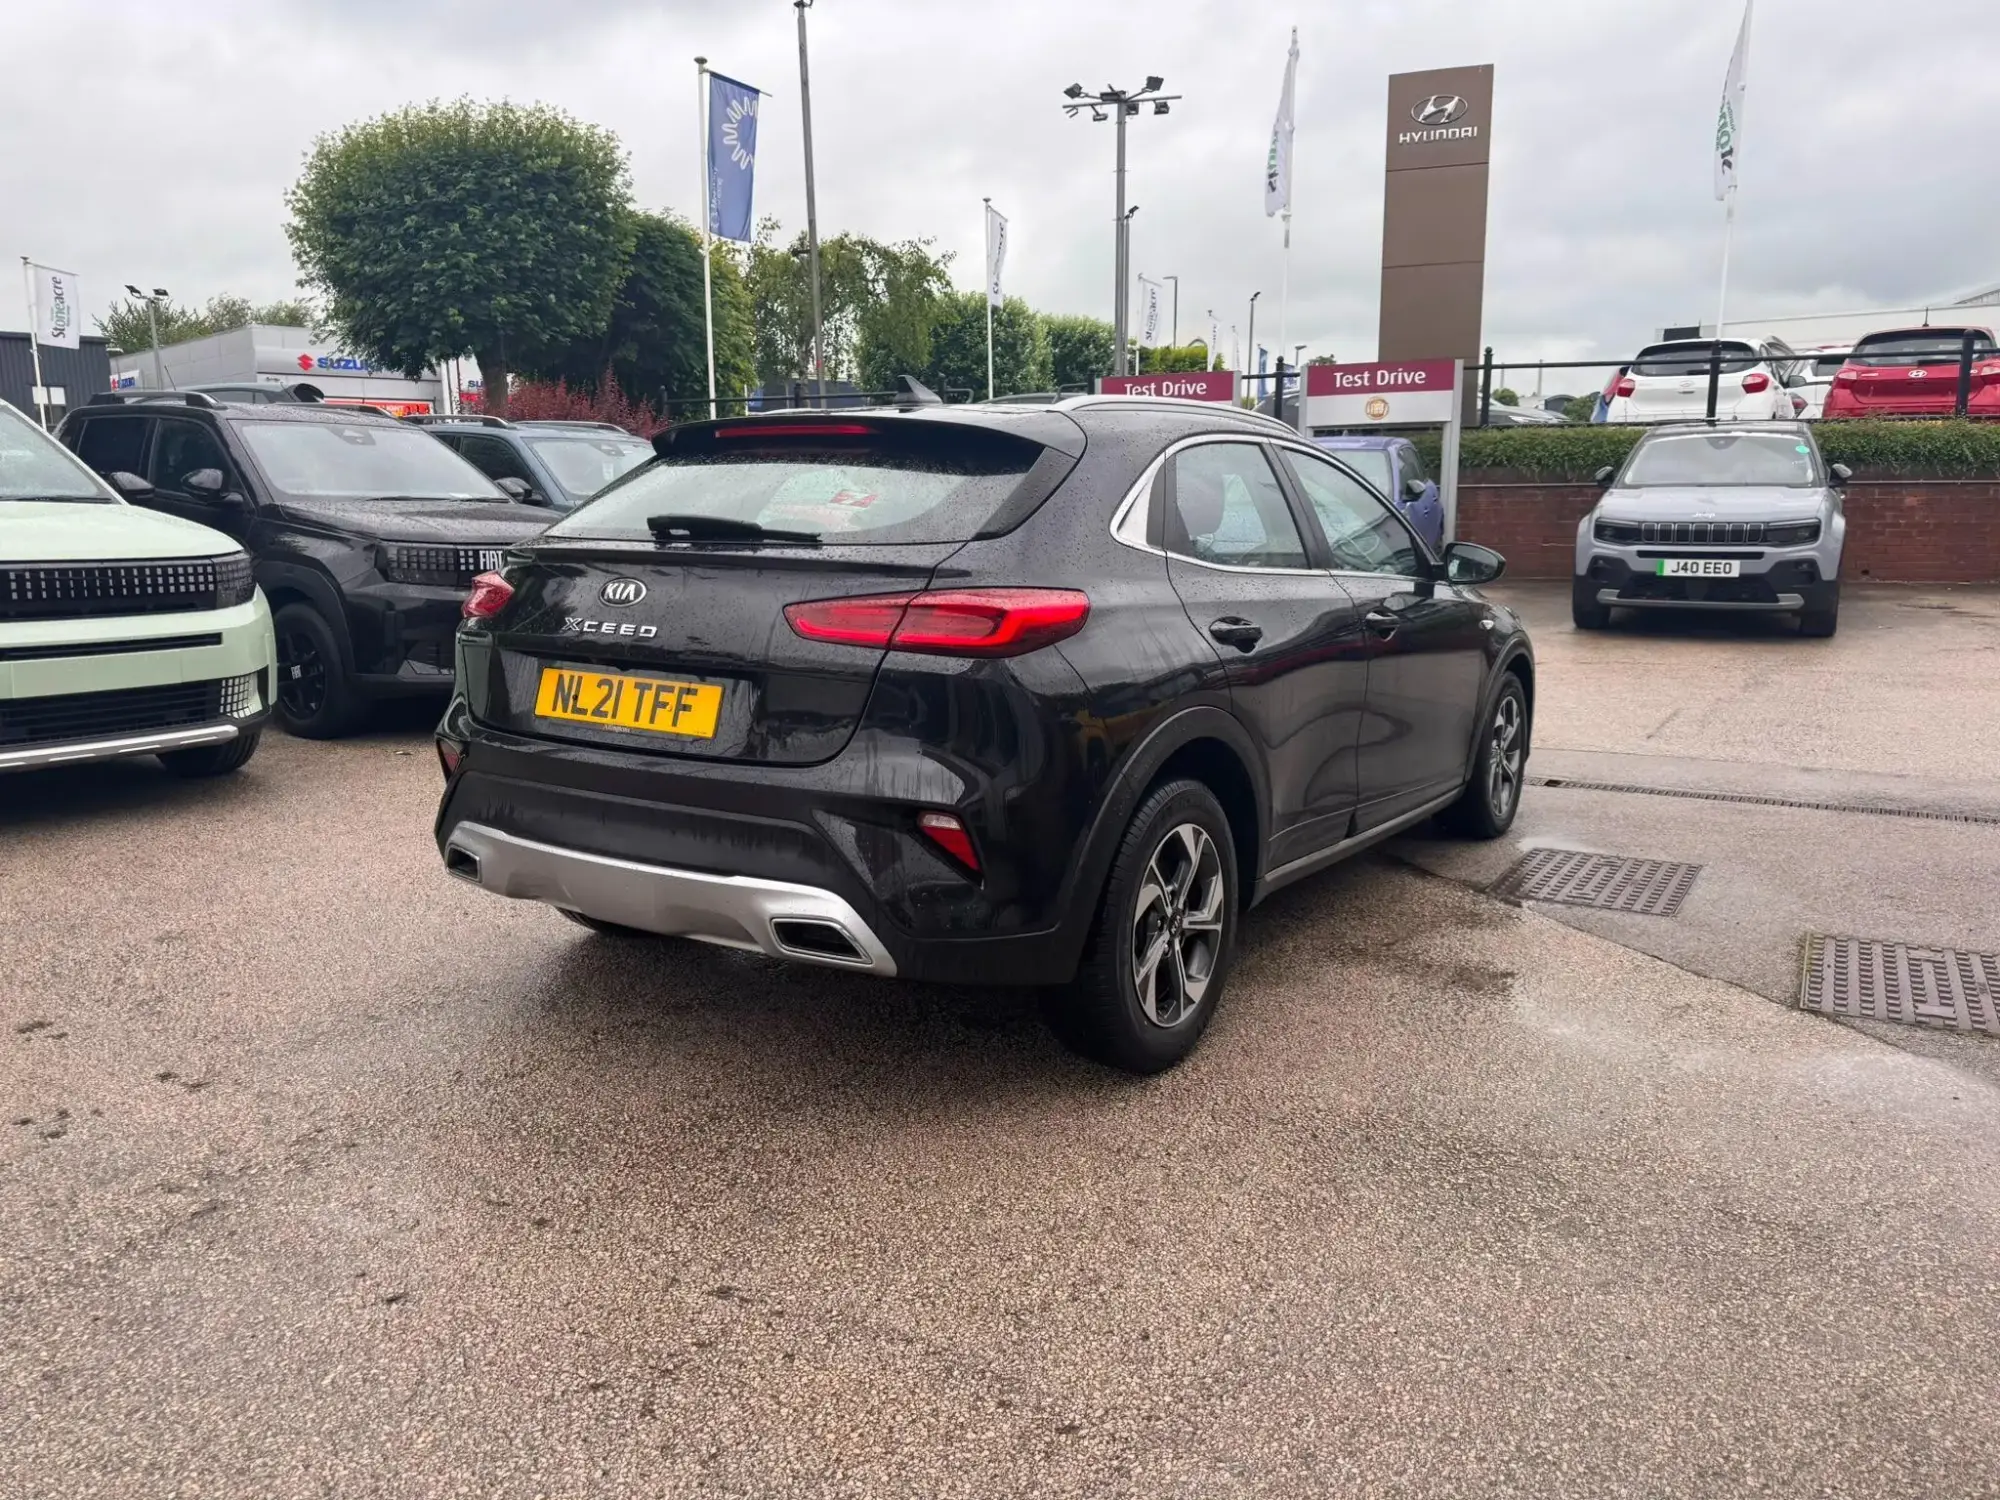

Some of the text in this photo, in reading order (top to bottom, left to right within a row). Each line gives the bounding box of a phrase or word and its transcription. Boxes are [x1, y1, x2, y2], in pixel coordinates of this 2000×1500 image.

[1398, 126, 1478, 144] HYUNDAI
[51, 276, 66, 339] Stoneacre
[1334, 368, 1427, 388] Test Drive
[1124, 380, 1207, 397] Test Drive
[479, 550, 503, 571] FIAT
[1671, 561, 1700, 574] J40
[604, 583, 636, 601] KIA
[560, 617, 658, 638] XCEED
[551, 673, 699, 728] NL21 TFF
